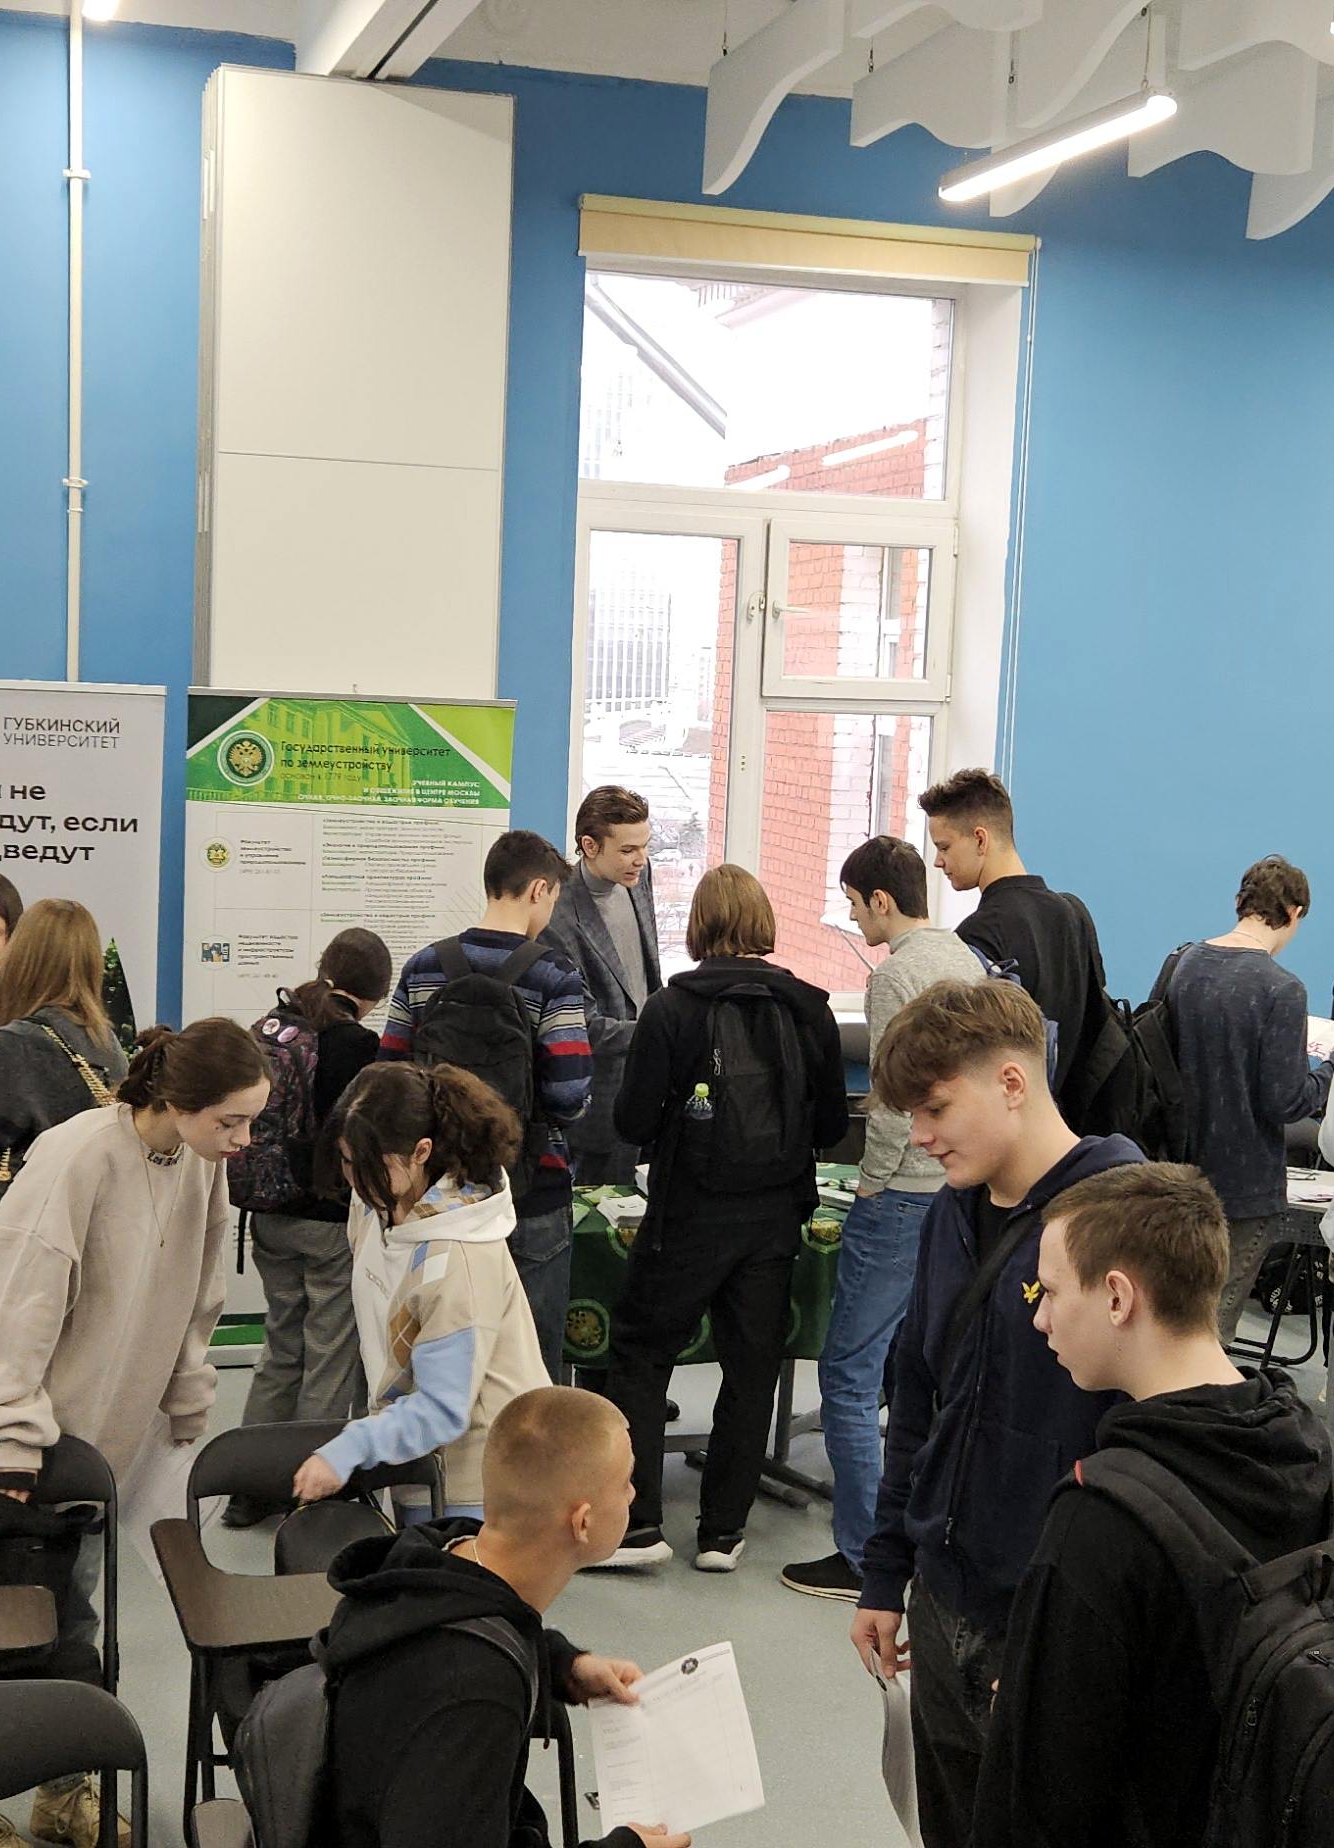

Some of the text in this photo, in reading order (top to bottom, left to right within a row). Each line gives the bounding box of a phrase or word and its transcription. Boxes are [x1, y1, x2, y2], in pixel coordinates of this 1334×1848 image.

[3, 716, 120, 734] ГУБКИНСКИЙ
[3, 733, 120, 749] УНИВЕРСИТЕТ
[281, 741, 450, 759] Государственный университет
[281, 759, 392, 772] по землеустройству
[10, 785, 47, 800] не
[63, 816, 139, 832] если
